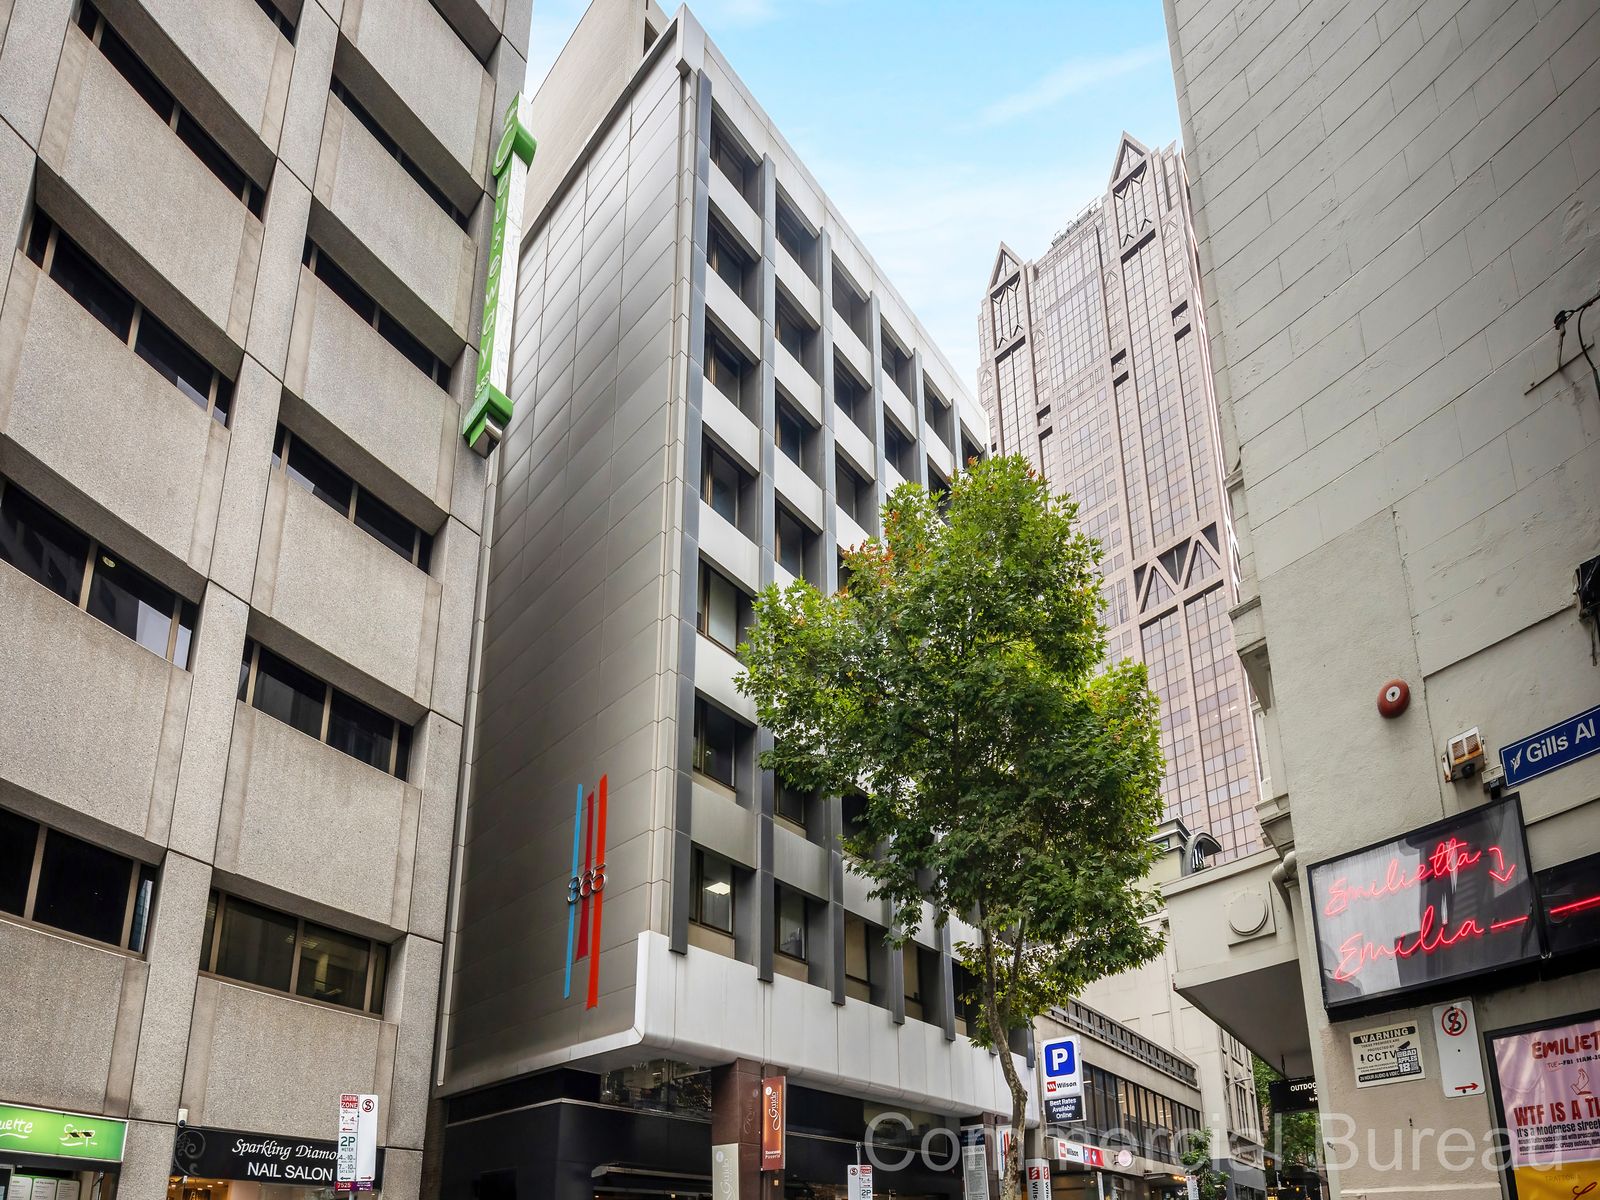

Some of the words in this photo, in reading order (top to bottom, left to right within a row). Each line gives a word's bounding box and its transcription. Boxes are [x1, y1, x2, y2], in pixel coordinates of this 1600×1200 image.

[481, 122, 514, 369] Causeway
[1526, 736, 1569, 763] Gills
[1574, 718, 1596, 744] Al
[567, 863, 606, 905] 365
[1324, 837, 1482, 916] Emilietta
[1334, 904, 1485, 982] Emilia
[1359, 1027, 1409, 1043] WARNING
[1051, 1047, 1069, 1071] P
[1367, 1050, 1398, 1063] CCTV
[1398, 1063, 1410, 1073] 18
[1057, 1081, 1077, 1089] Wilson
[341, 1101, 358, 1109] ZONE
[769, 1091, 782, 1131] Guido
[1050, 1099, 1061, 1107] Best
[1052, 1104, 1076, 1113] Available
[1513, 1103, 1545, 1127] WTF
[1550, 1101, 1566, 1123] IS
[1571, 1099, 1582, 1121] A
[1537, 1122, 1576, 1136] Modenese
[232, 1138, 292, 1161] Sparkling
[295, 1145, 339, 1160] Diamo
[340, 1136, 356, 1147] 2P
[247, 1161, 282, 1178] NAIL
[284, 1164, 334, 1181] SALON
[861, 1189, 872, 1197] 2P
